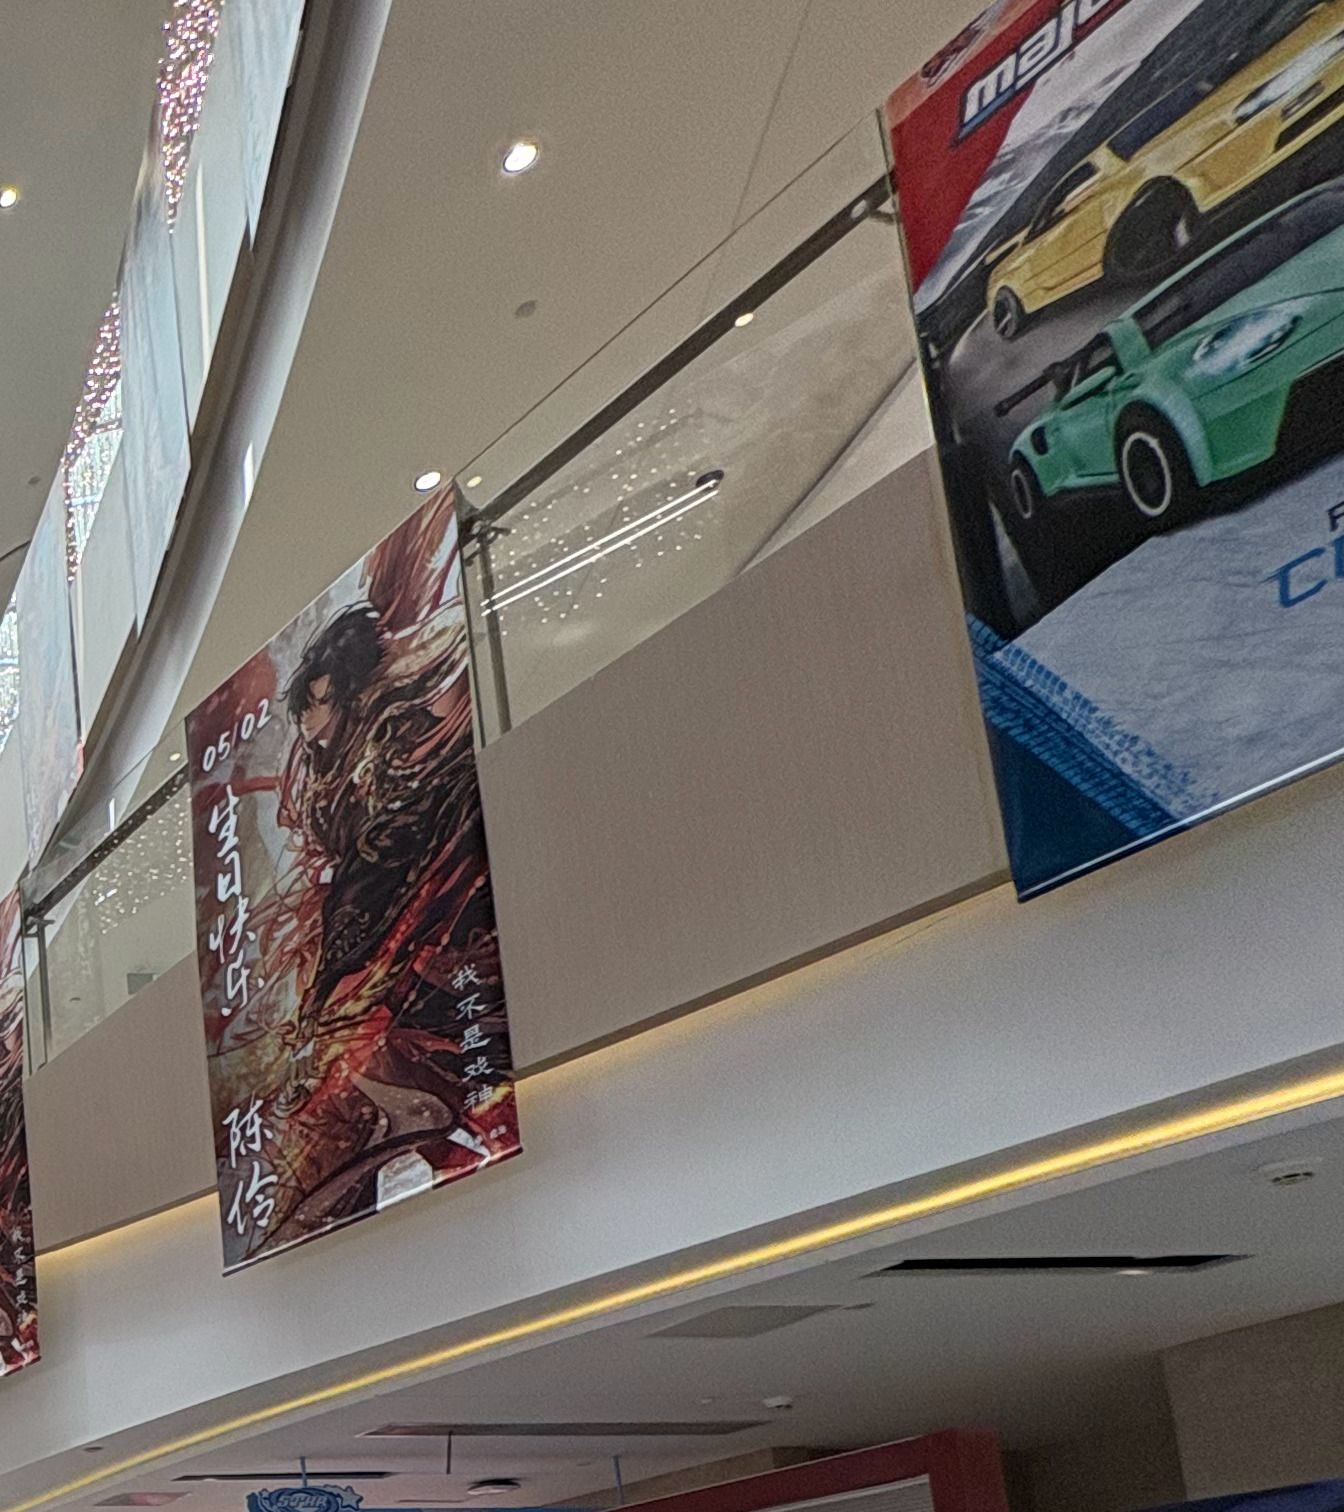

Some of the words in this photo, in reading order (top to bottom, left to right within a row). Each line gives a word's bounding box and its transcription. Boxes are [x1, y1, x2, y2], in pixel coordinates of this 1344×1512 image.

[201, 697, 273, 775] 05/02
[206, 784, 266, 1019] 生日快乐
[451, 962, 497, 1115] 我不是戏神
[220, 1096, 281, 1240] 陈伶
